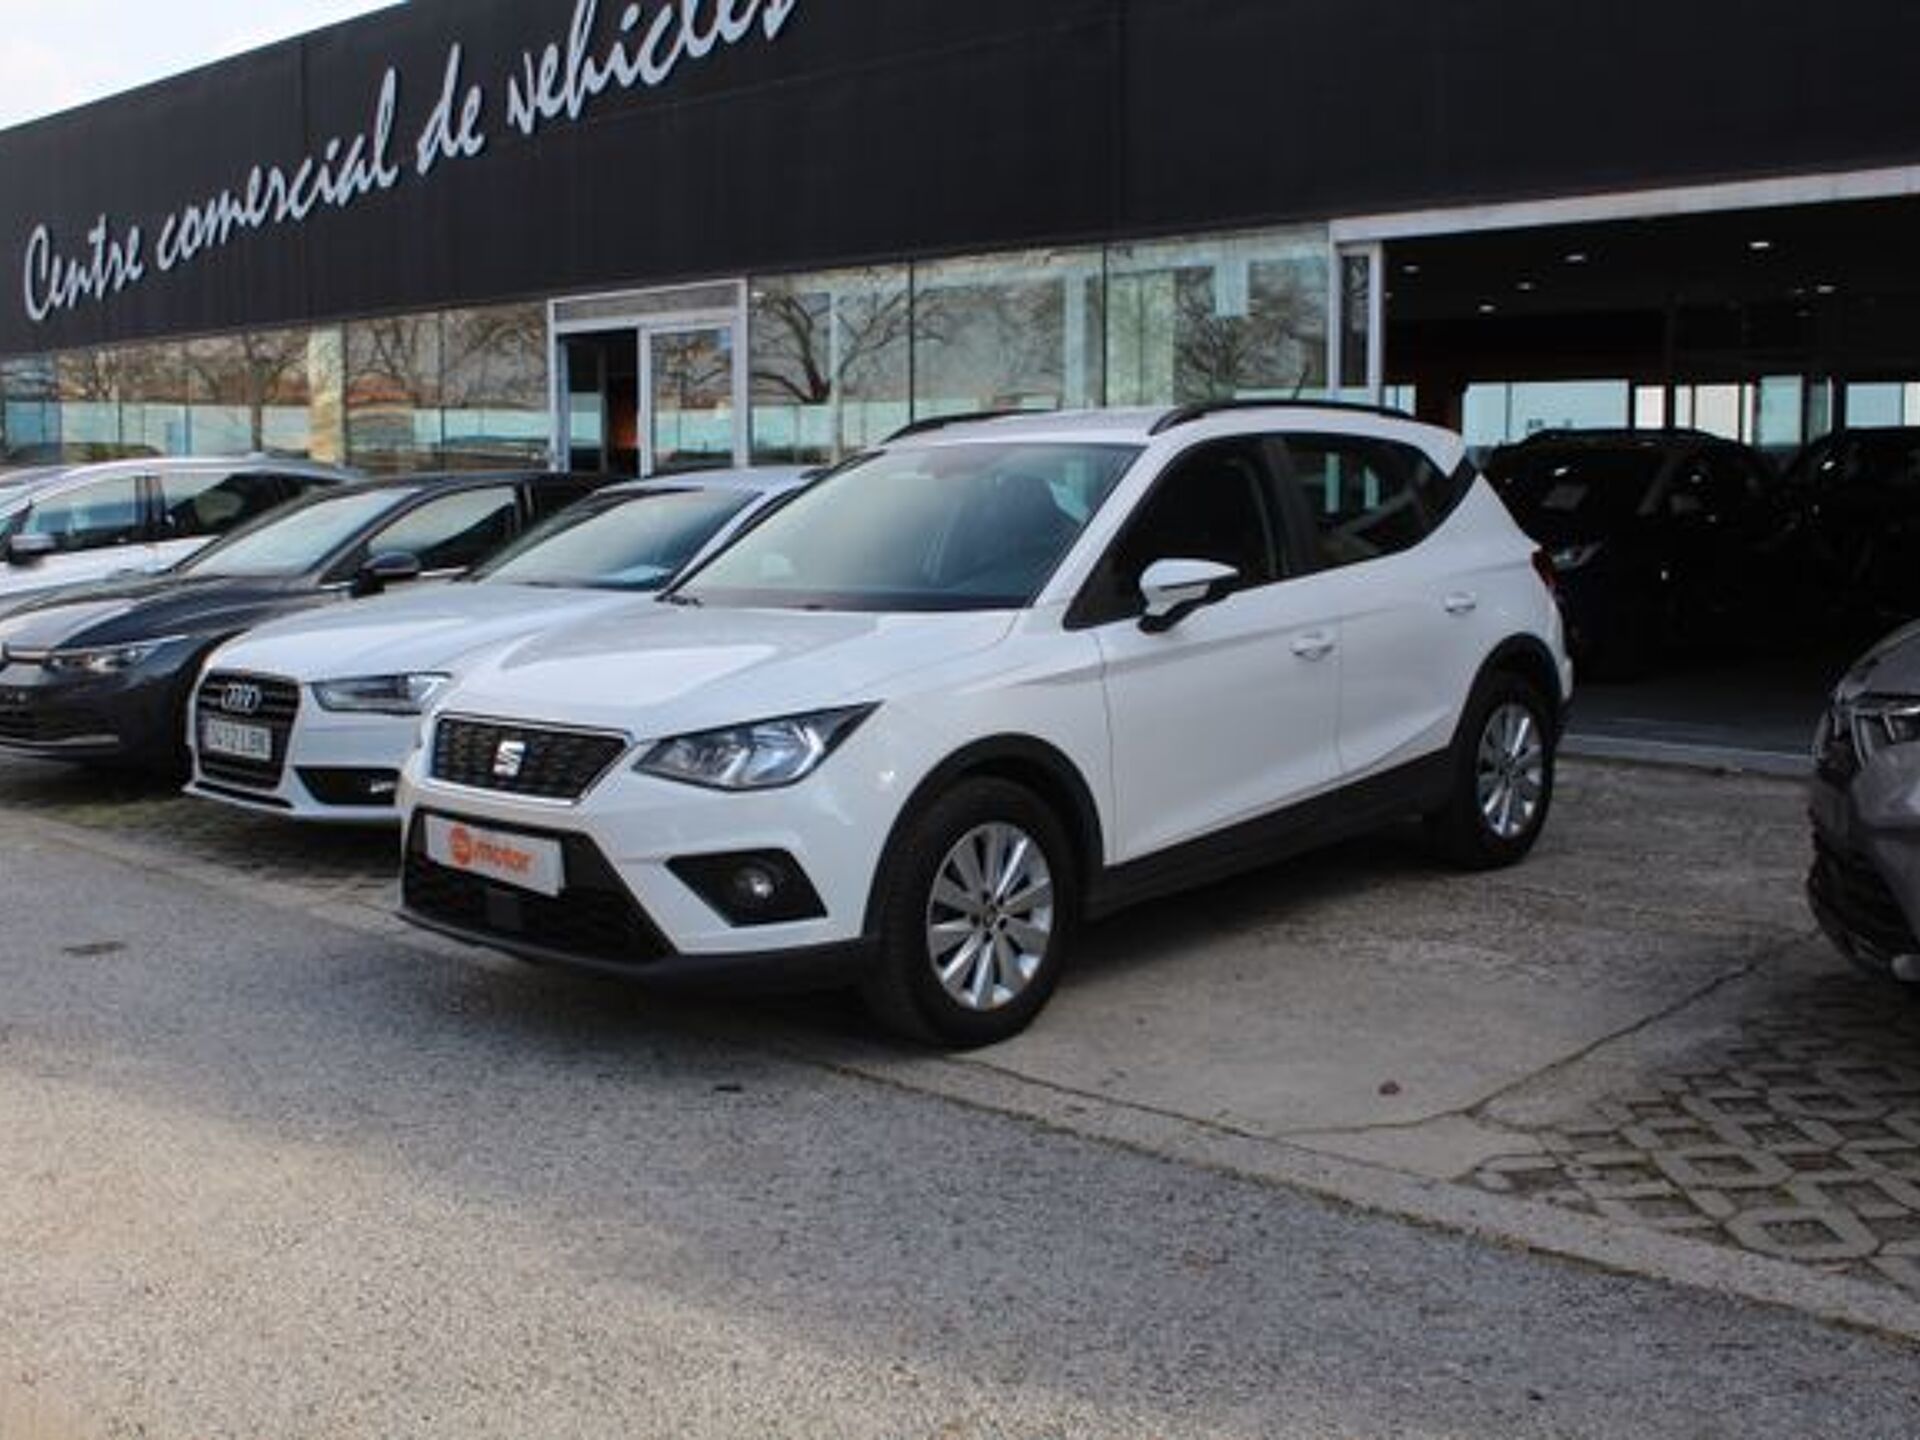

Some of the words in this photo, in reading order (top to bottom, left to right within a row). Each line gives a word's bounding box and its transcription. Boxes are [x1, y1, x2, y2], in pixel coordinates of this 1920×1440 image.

[24, 214, 142, 321] Centre
[156, 68, 398, 270] comercial
[417, 43, 484, 175] de
